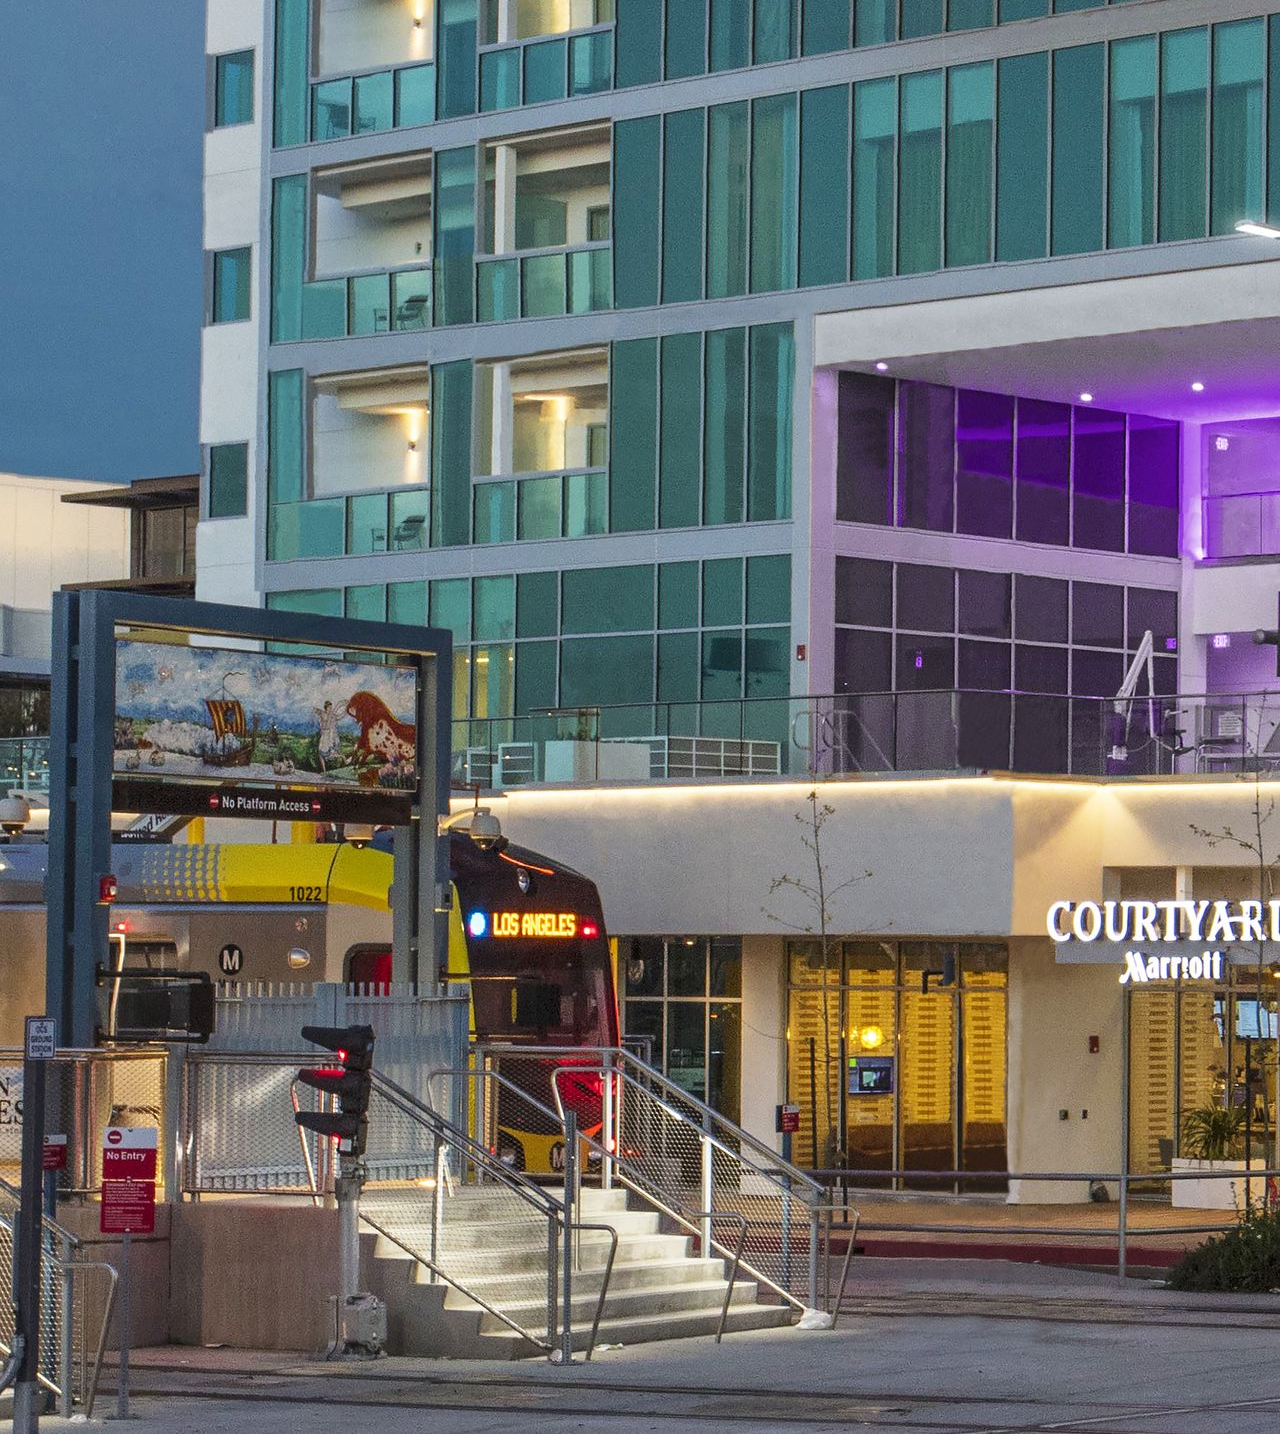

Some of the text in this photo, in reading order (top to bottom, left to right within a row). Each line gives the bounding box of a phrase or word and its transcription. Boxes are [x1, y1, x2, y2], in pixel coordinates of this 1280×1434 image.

[222, 797, 309, 812] No Platform Access
[289, 886, 322, 901] 1022
[493, 912, 576, 937] LOS ANGELES
[1118, 950, 1222, 984] Marriott
[106, 1151, 146, 1162] No Entry
